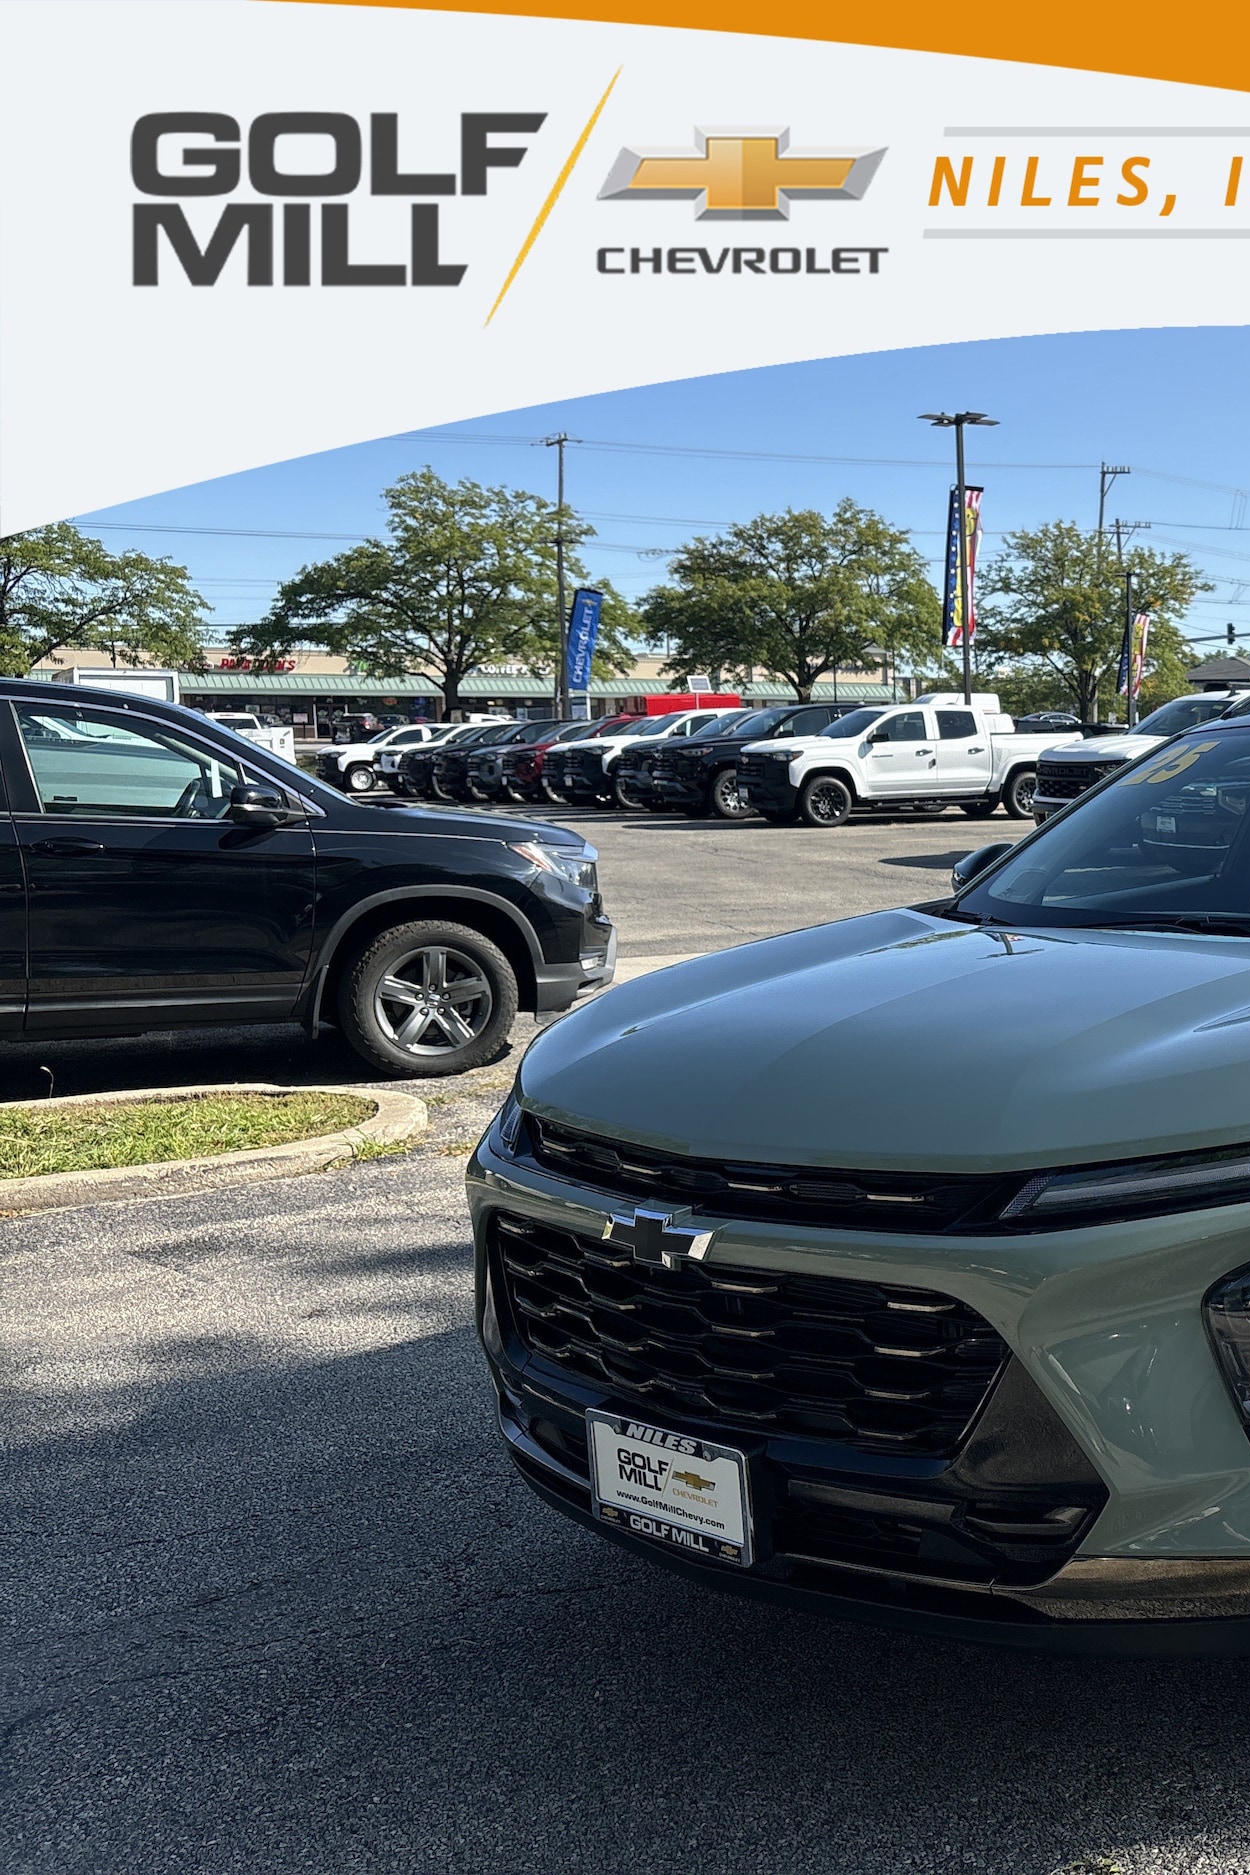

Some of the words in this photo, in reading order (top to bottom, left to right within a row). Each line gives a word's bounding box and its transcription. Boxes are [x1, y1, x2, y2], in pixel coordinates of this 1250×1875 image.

[573, 607, 593, 683] CHEVROLET
[626, 1423, 698, 1454] NILES
[616, 1448, 669, 1476] GOLF
[618, 1463, 662, 1492] MILL
[616, 1489, 725, 1530] www.GolfMillChevy.com
[672, 1487, 718, 1508] CHEVROLET
[629, 1514, 670, 1538] GOLF
[671, 1526, 710, 1552] MILL
